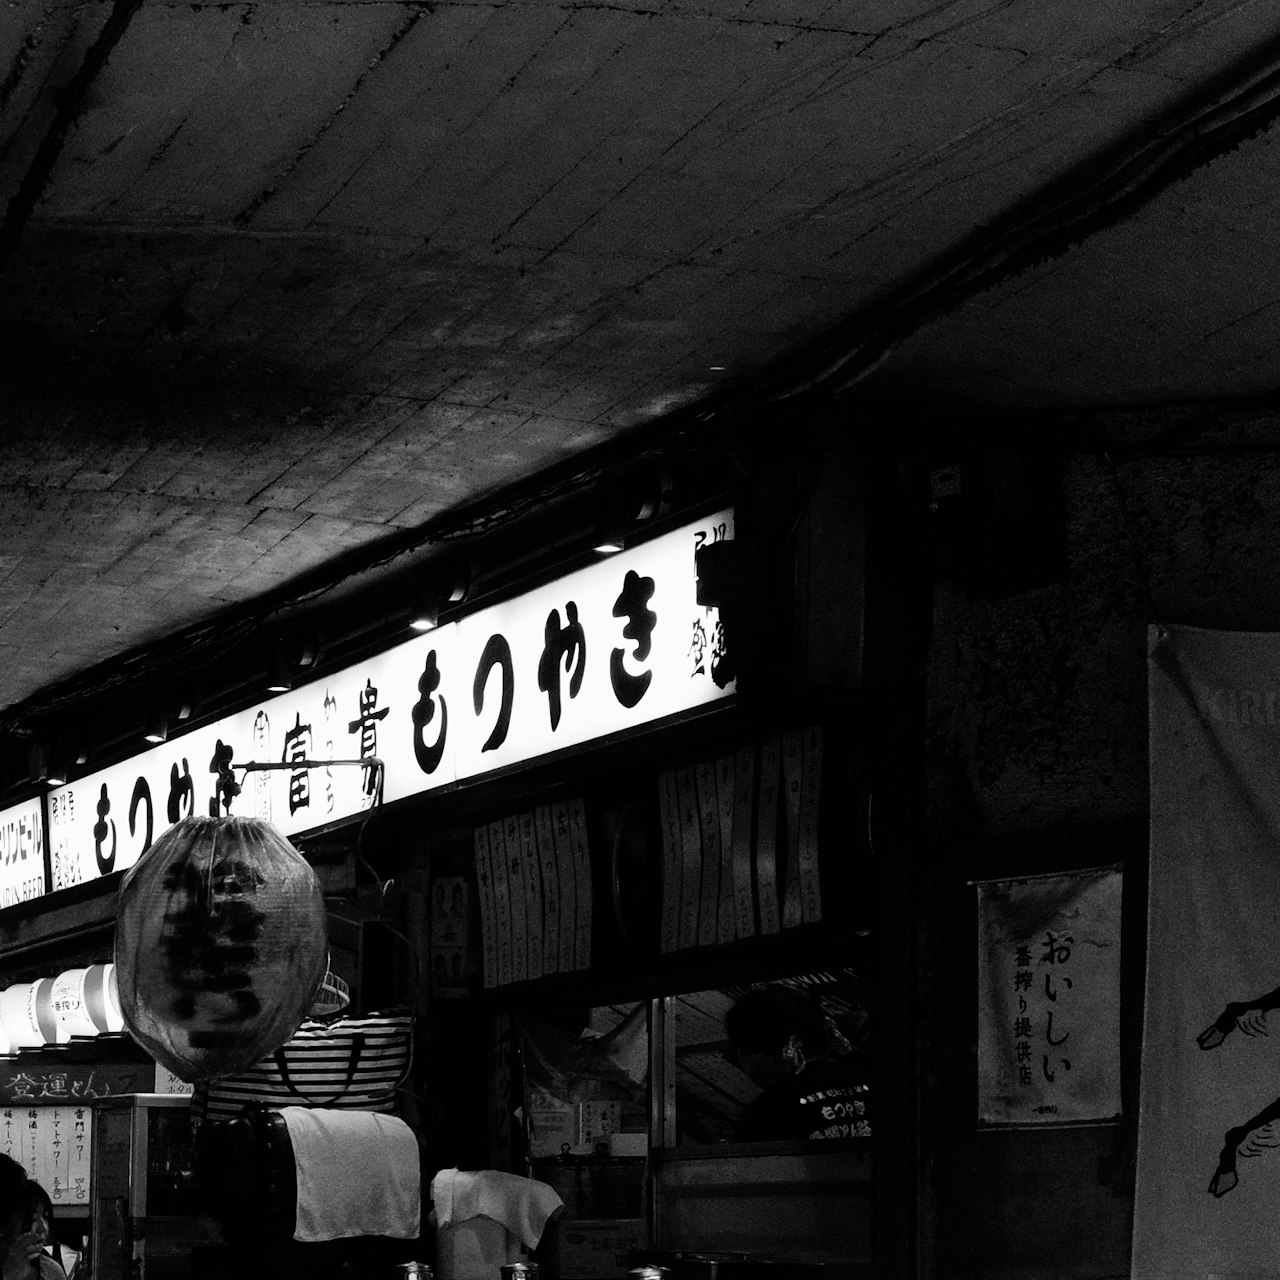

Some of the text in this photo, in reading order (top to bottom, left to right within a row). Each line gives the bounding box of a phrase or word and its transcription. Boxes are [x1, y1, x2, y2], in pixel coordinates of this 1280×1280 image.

[411, 569, 658, 776] もつやき
[22, 875, 43, 902] BEER
[1013, 935, 1033, 1087] 一番搾り提供店
[1040, 931, 1074, 1083] おいしい
[52, 1110, 61, 1167] トマトサワー
